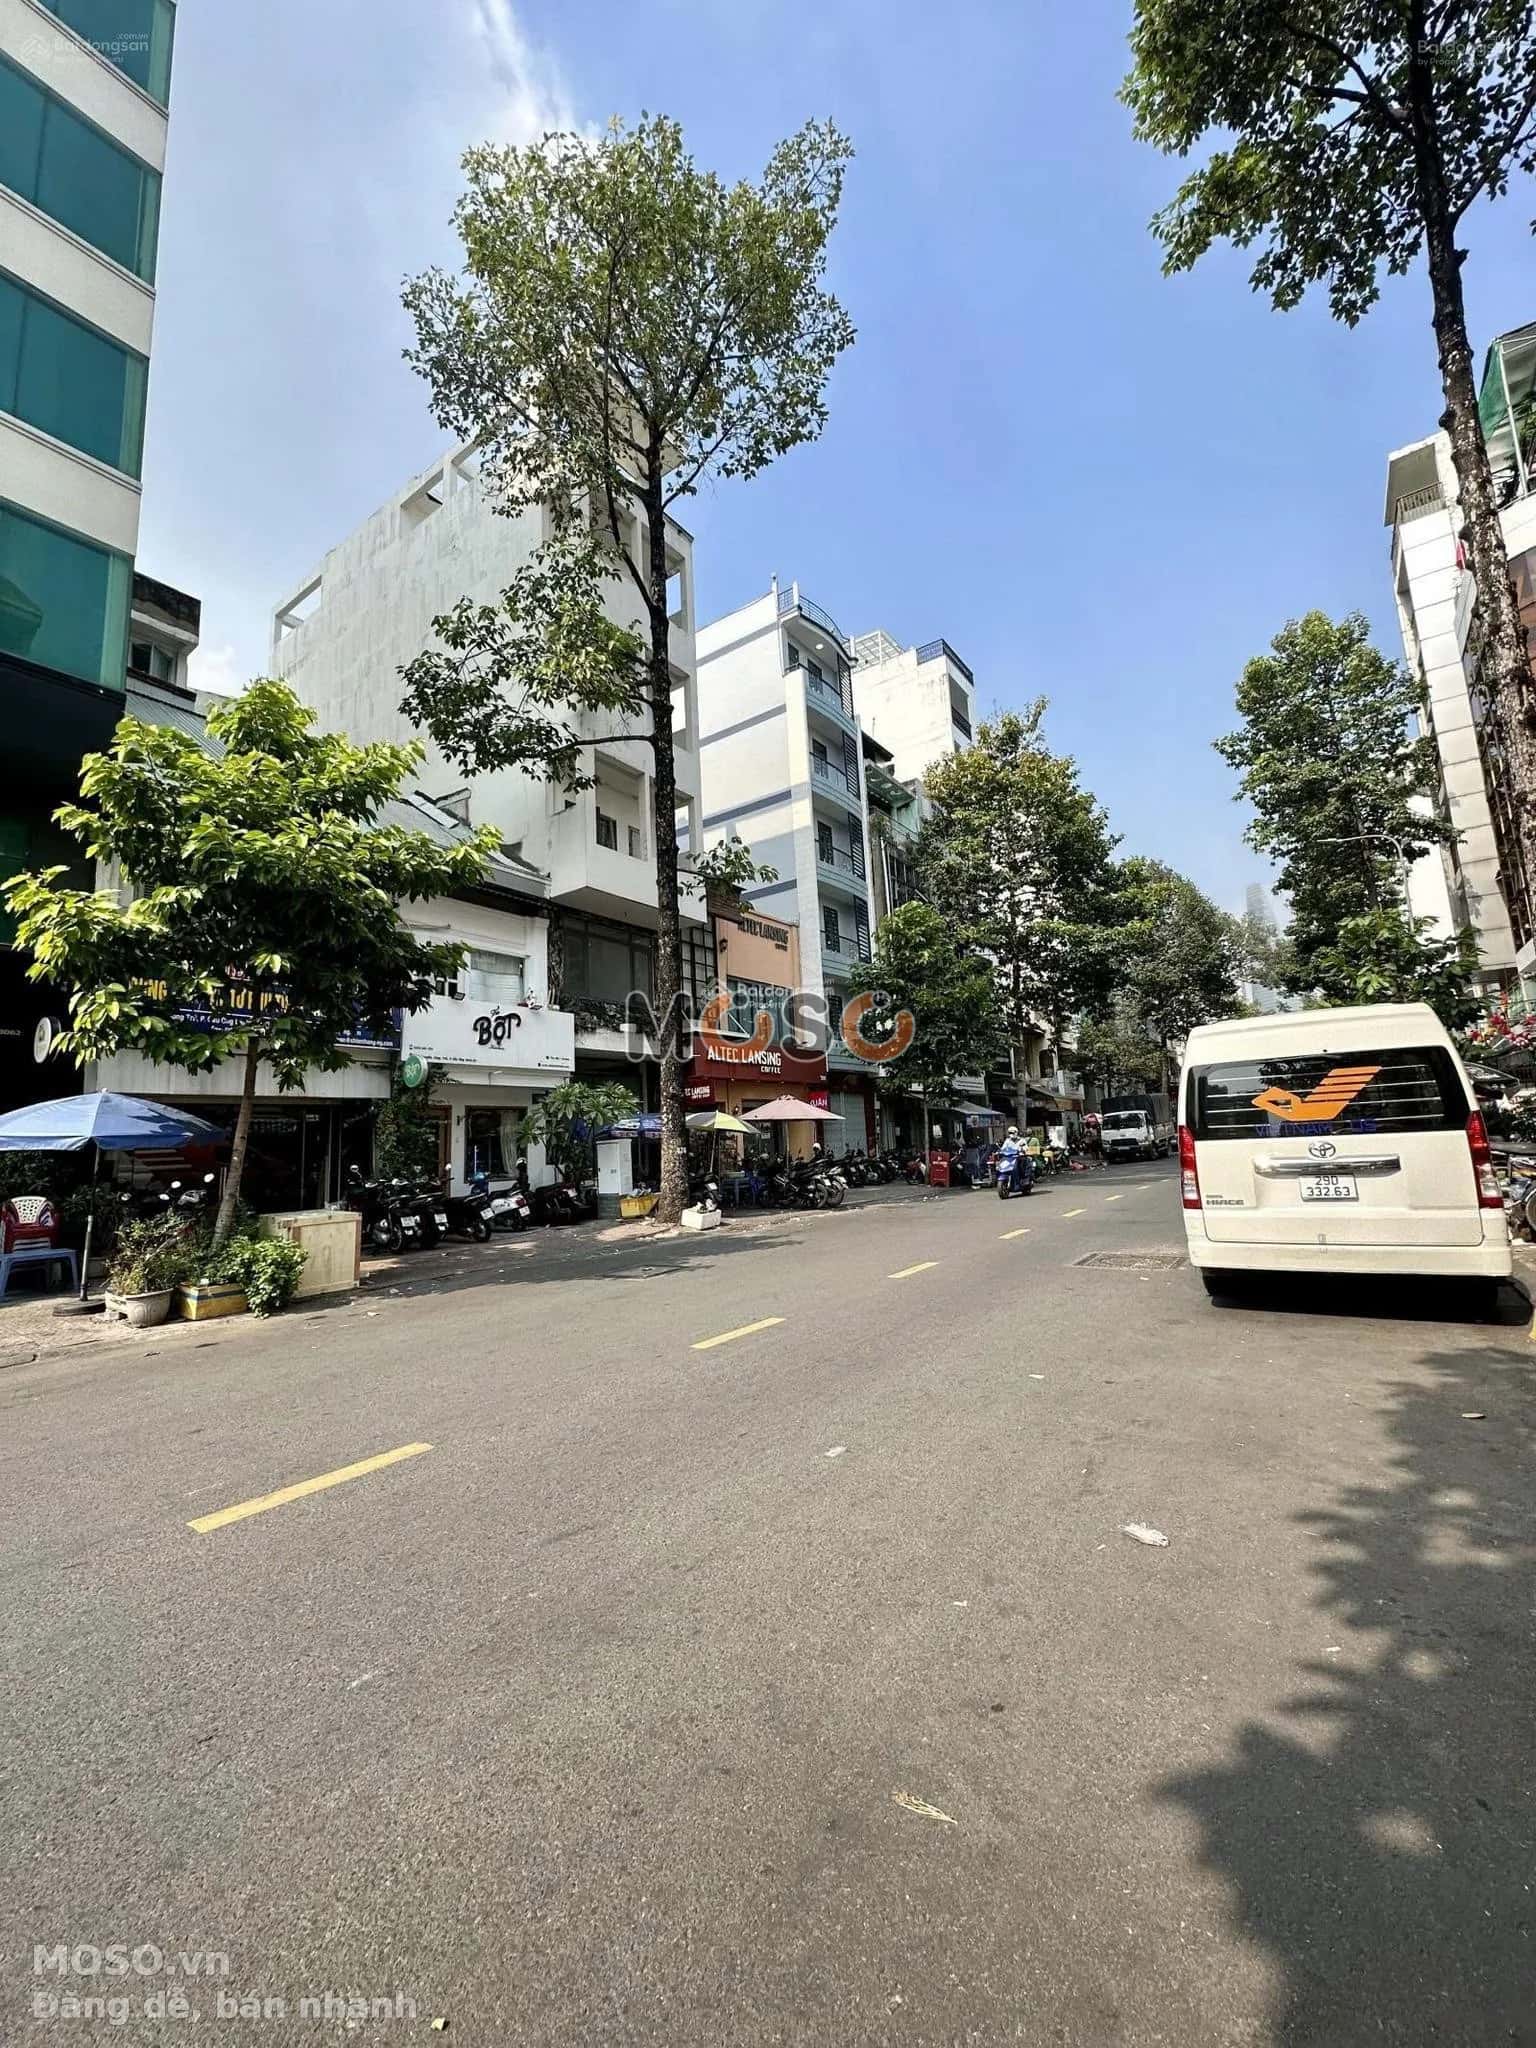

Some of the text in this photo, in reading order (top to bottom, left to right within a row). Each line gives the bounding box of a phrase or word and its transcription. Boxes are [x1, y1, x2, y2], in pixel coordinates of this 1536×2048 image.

[707, 1045, 782, 1066] ALTEC LANSING
[1306, 1186, 1351, 1197] 332.63
